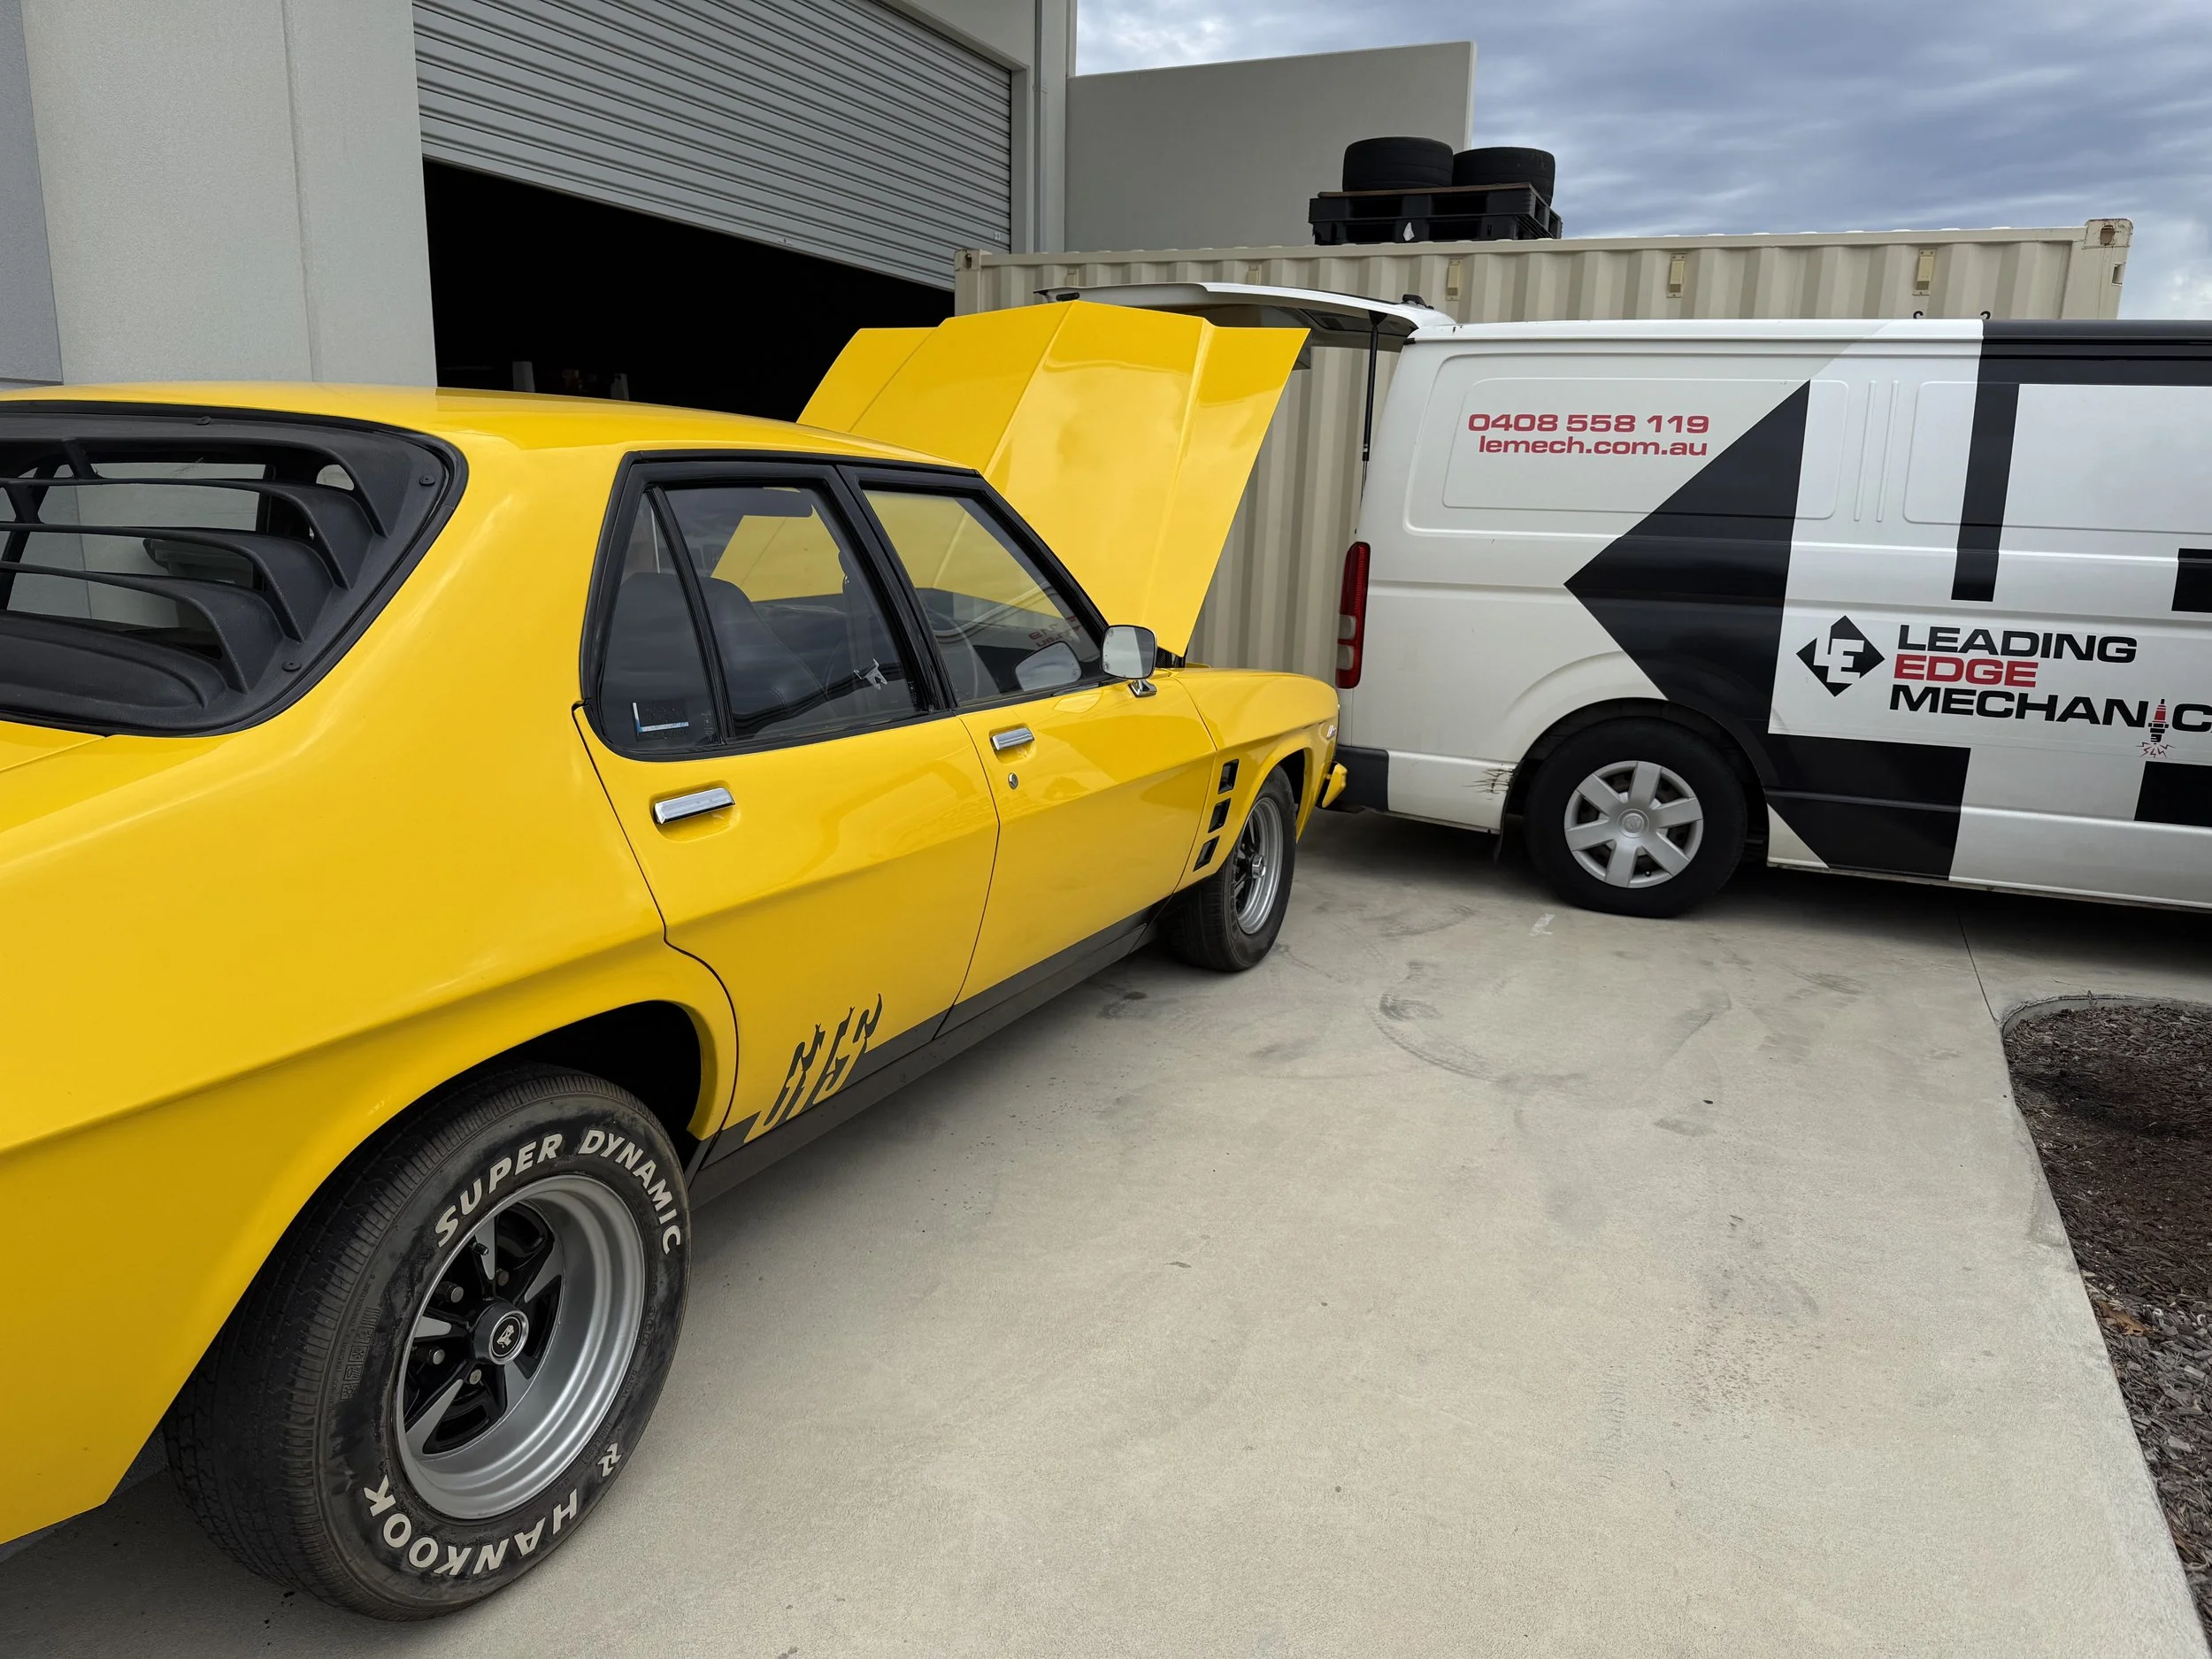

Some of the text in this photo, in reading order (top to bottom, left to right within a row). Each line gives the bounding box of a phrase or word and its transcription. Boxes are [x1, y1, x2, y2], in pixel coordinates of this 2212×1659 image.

[1468, 413, 1709, 434] 0408 558 119
[1479, 435, 1708, 457] lemech.com.au
[1897, 624, 2138, 664] LEADING
[1893, 654, 2039, 687] EDGE
[1889, 684, 2212, 741] MECHANIC
[434, 1129, 682, 1256] SUPER DYNAMIC
[363, 1474, 579, 1576] HANKOOK
